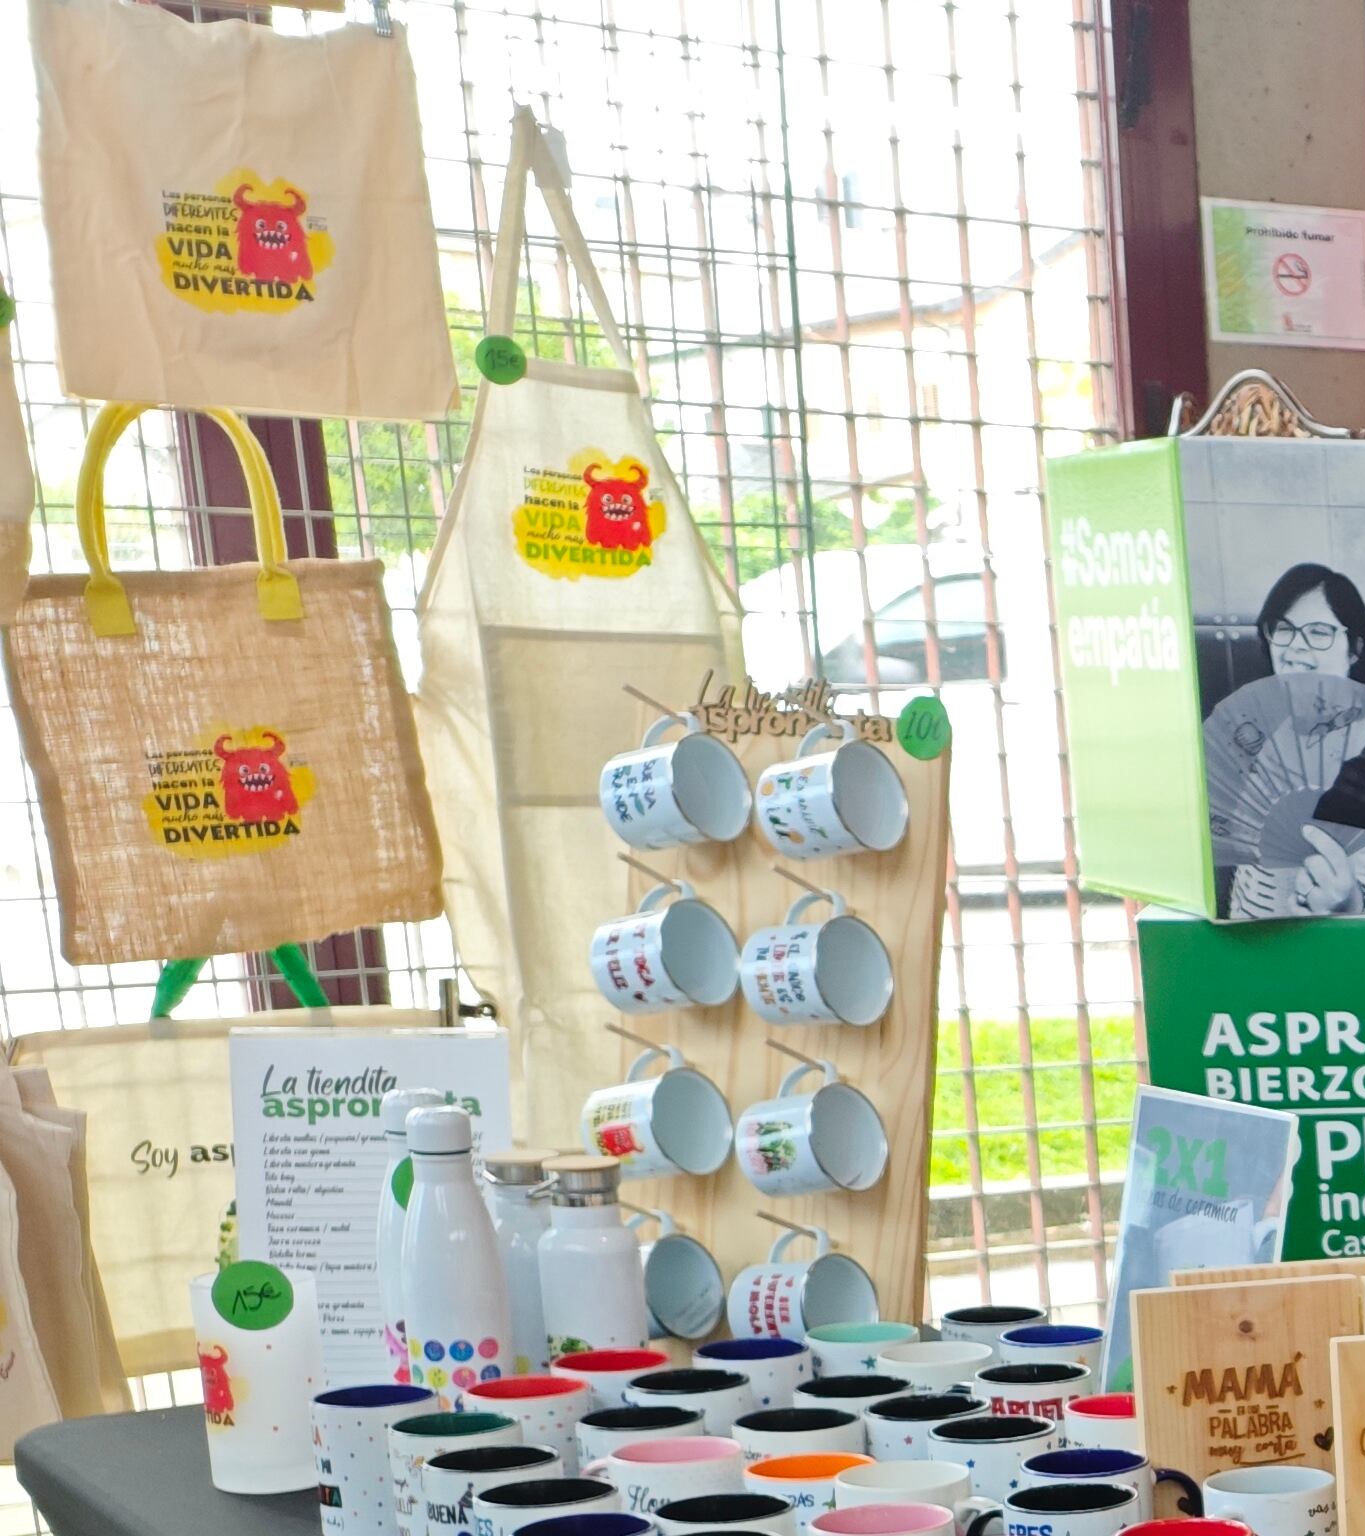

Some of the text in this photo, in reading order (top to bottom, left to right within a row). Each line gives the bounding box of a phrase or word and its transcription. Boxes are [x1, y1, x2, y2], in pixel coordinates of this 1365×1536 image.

[166, 221, 230, 237] hacen la
[167, 237, 232, 260] VIDA
[173, 272, 315, 302] DIVERTIDA
[524, 509, 581, 531] VIDA
[525, 541, 652, 567] DIVERTIDA
[1058, 513, 1173, 591] #Somos
[1068, 596, 1180, 686] empatía
[155, 792, 219, 811] VIDA
[163, 818, 300, 844] DIVERTIDA
[261, 1064, 398, 1098] La tiendita
[131, 1138, 178, 1178] Soy
[231, 1283, 282, 1315] 15€
[1183, 1352, 1305, 1405] MAMÁ
[1209, 1409, 1294, 1440] PALABRA
